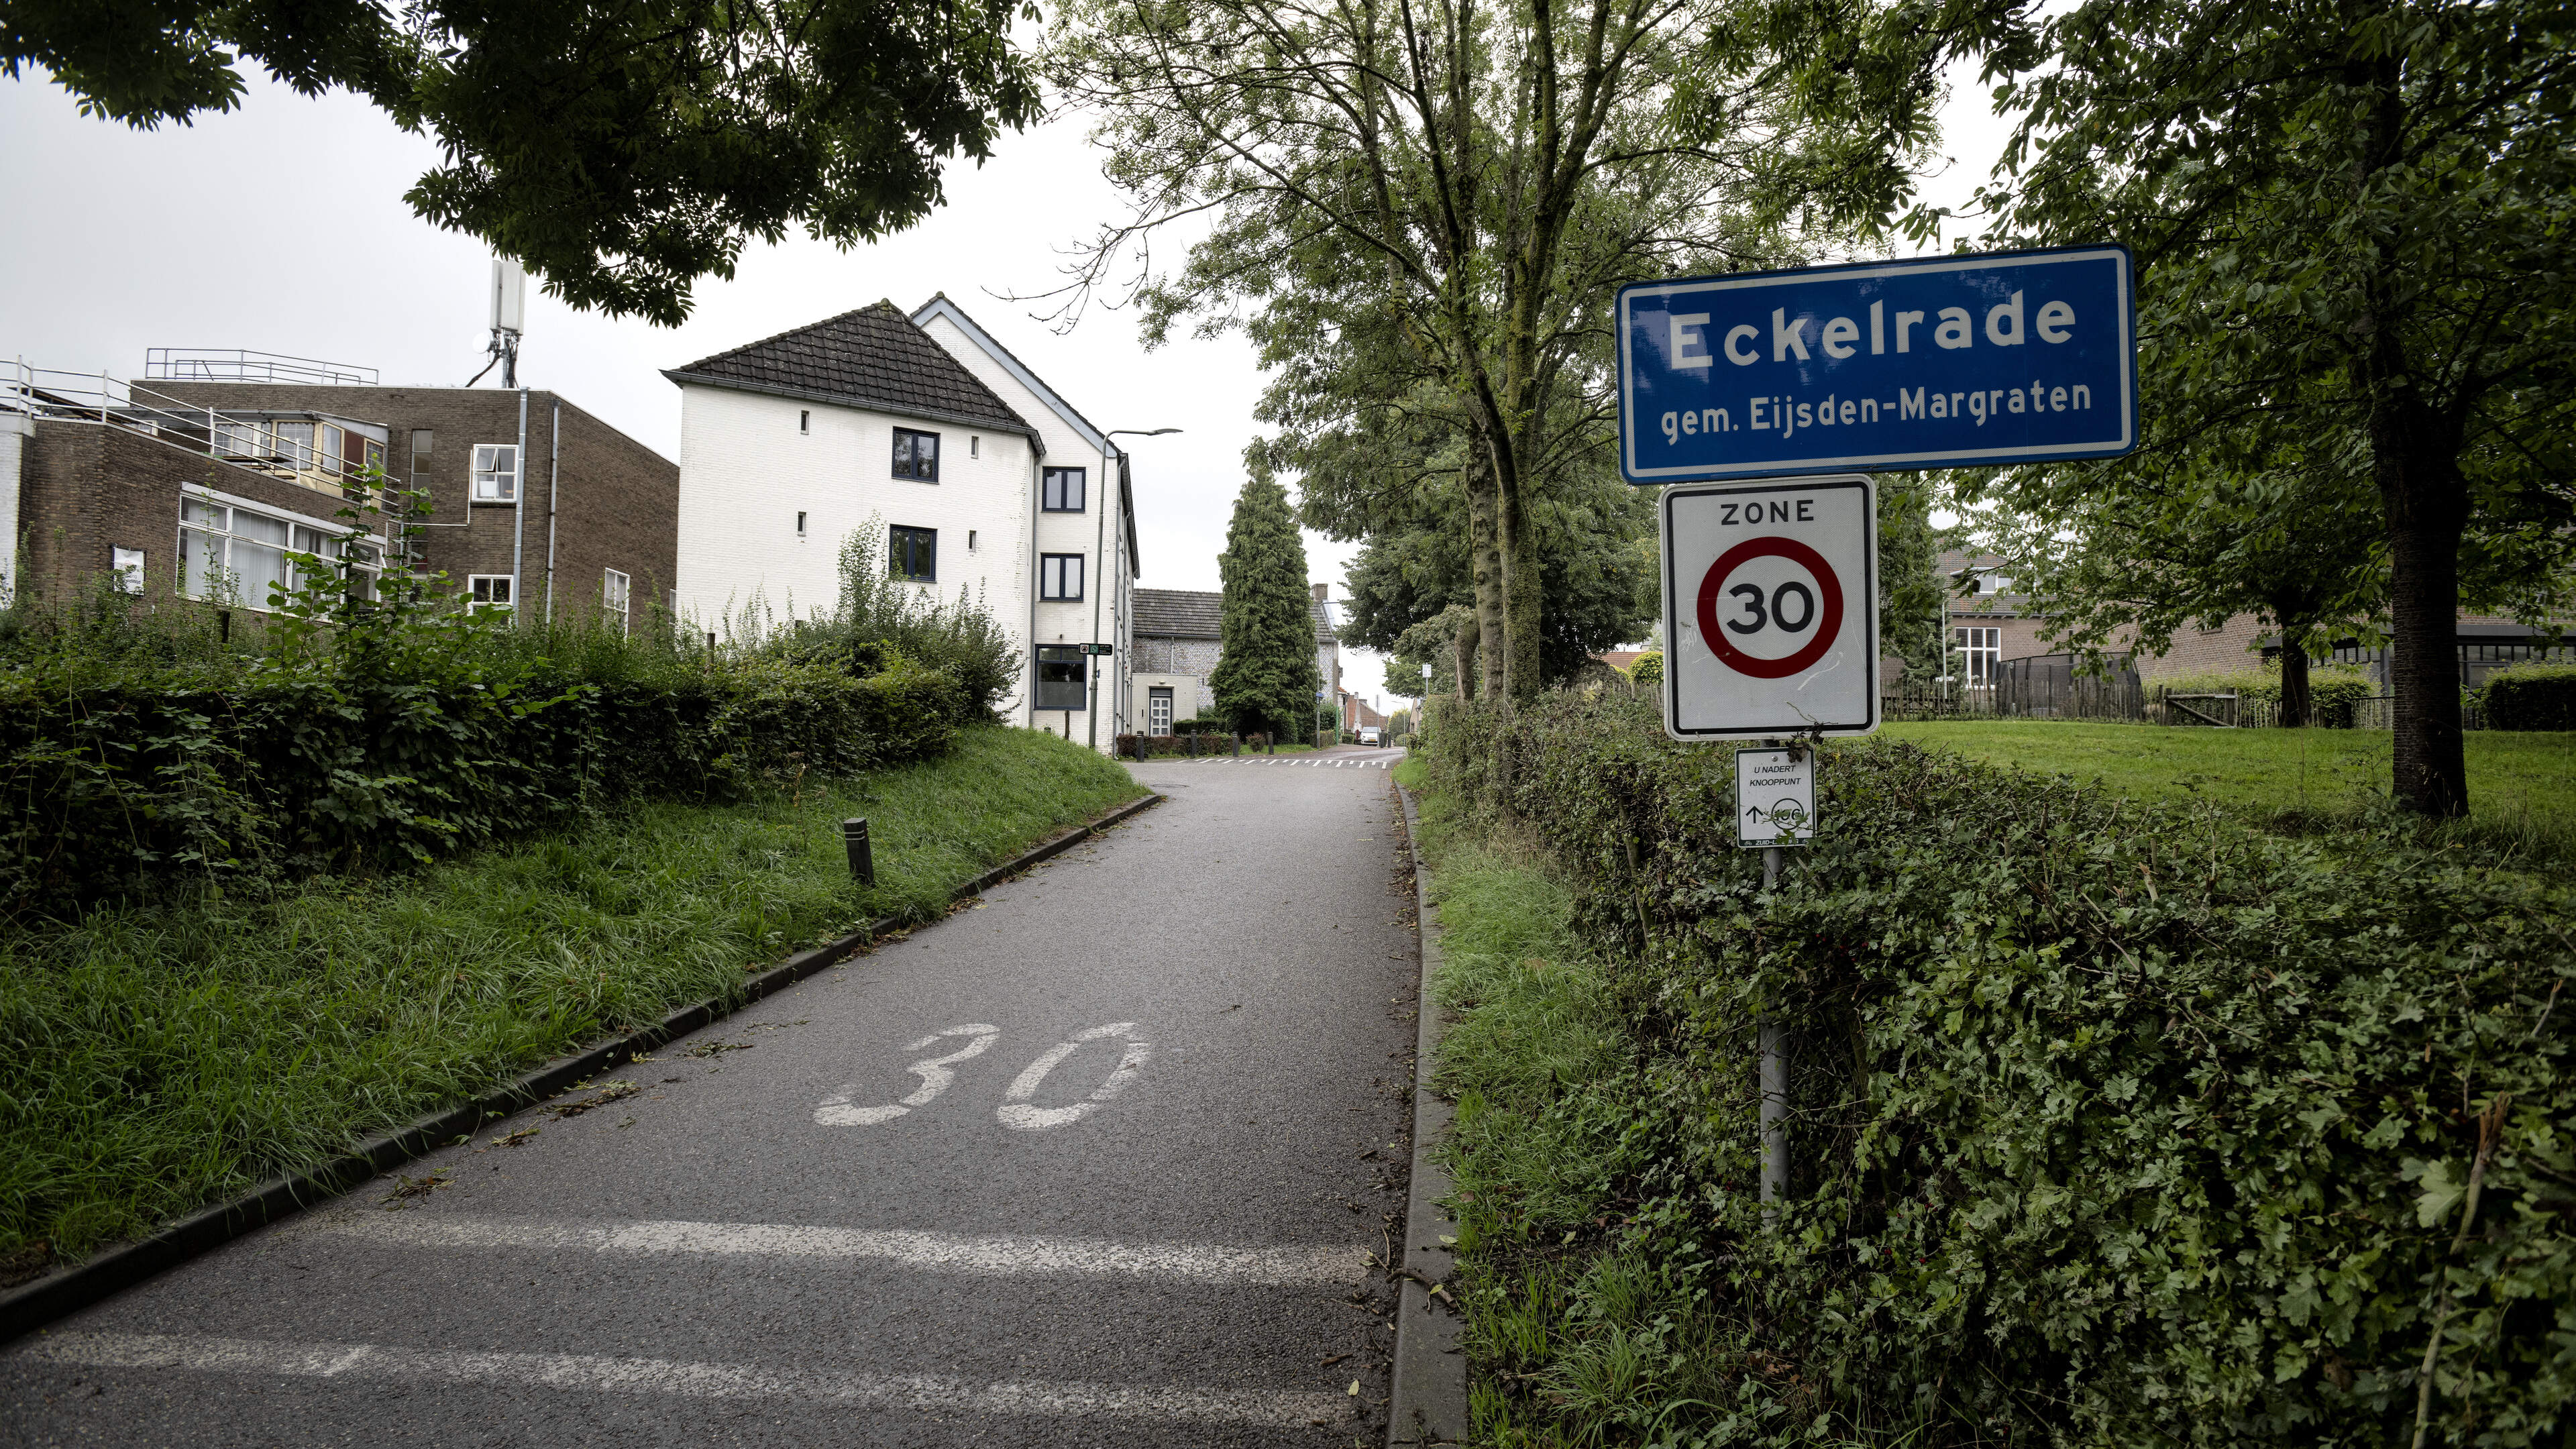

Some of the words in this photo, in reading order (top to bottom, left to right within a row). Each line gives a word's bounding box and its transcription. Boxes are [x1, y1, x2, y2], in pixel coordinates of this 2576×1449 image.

[1670, 290, 2076, 370] Eckelrade
[1661, 406, 1739, 446] gem.
[1750, 380, 2091, 439] Eijsden-Margraten
[1721, 499, 1815, 525] ZONE
[1727, 581, 1815, 635] 30
[1750, 777, 1801, 786] KNOOPPUNT
[1762, 765, 1796, 773] NADERT
[814, 1022, 1150, 1130] 30
